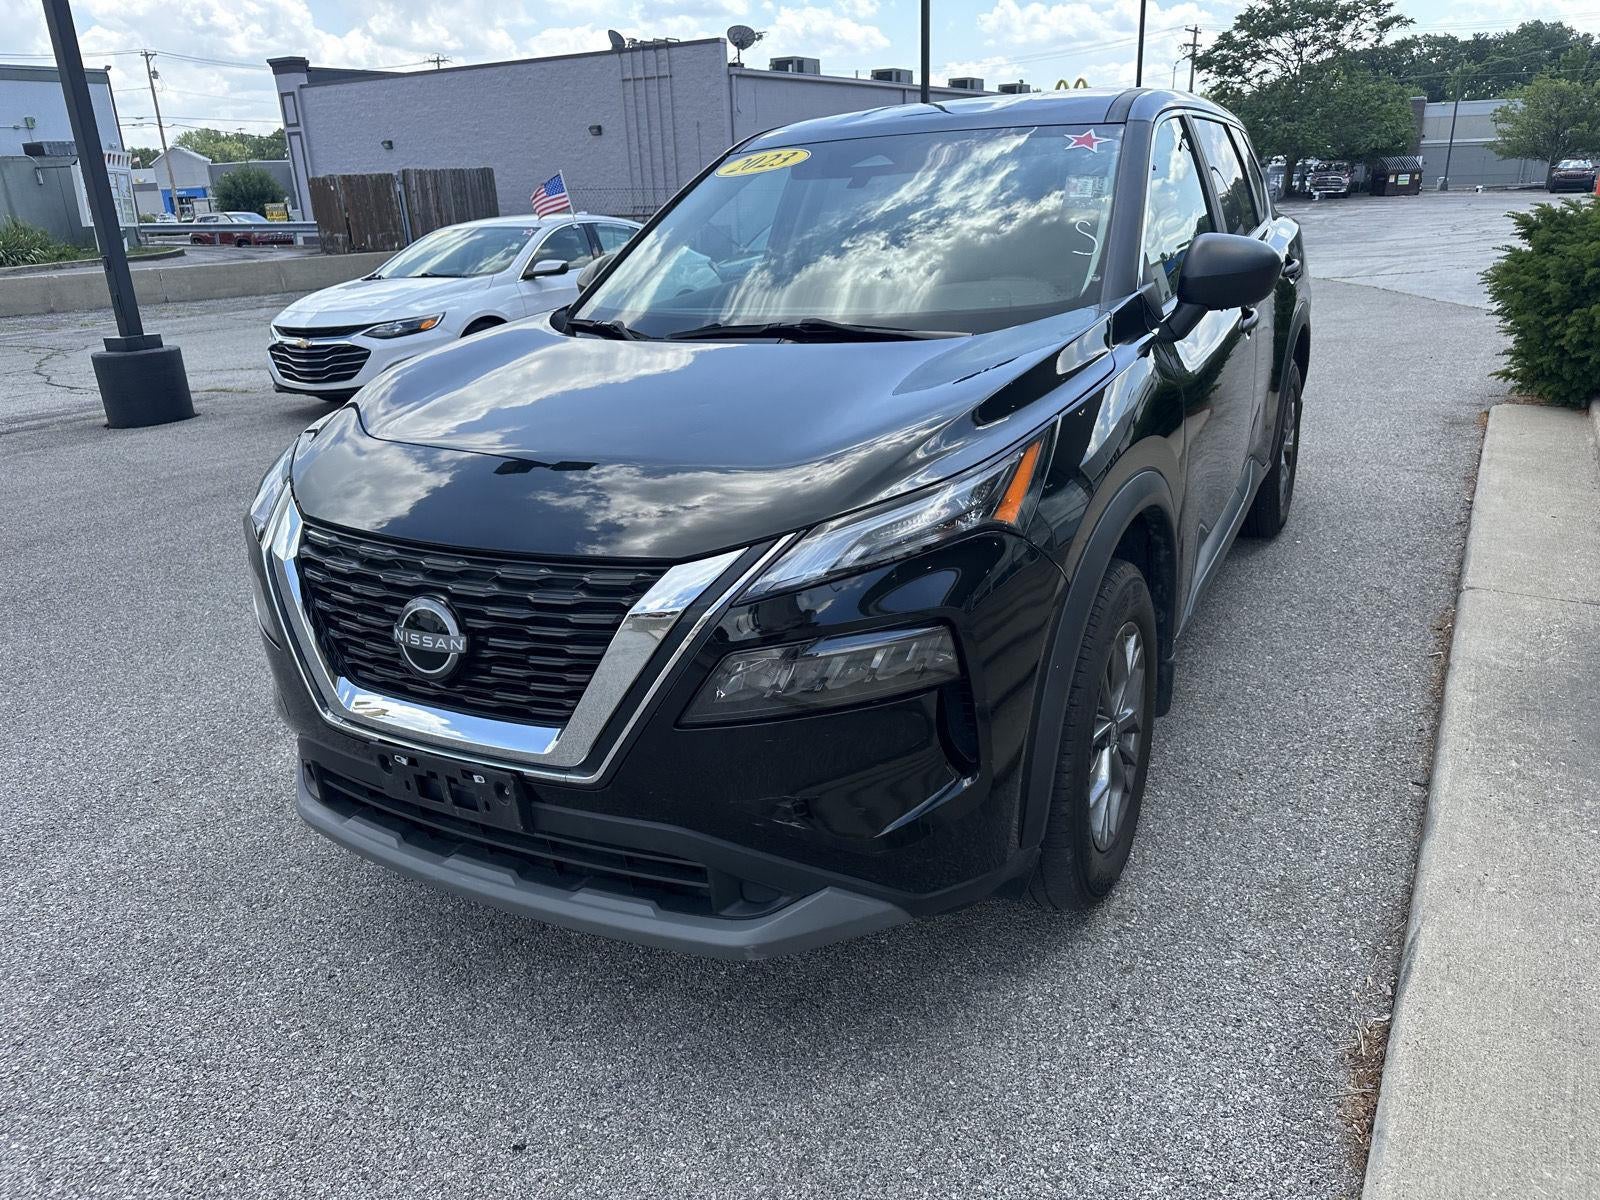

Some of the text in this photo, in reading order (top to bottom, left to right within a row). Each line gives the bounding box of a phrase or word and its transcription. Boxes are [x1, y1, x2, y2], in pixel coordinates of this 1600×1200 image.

[724, 151, 799, 174] 2023
[1072, 220, 1099, 256] S
[394, 628, 464, 651] NISSAN
